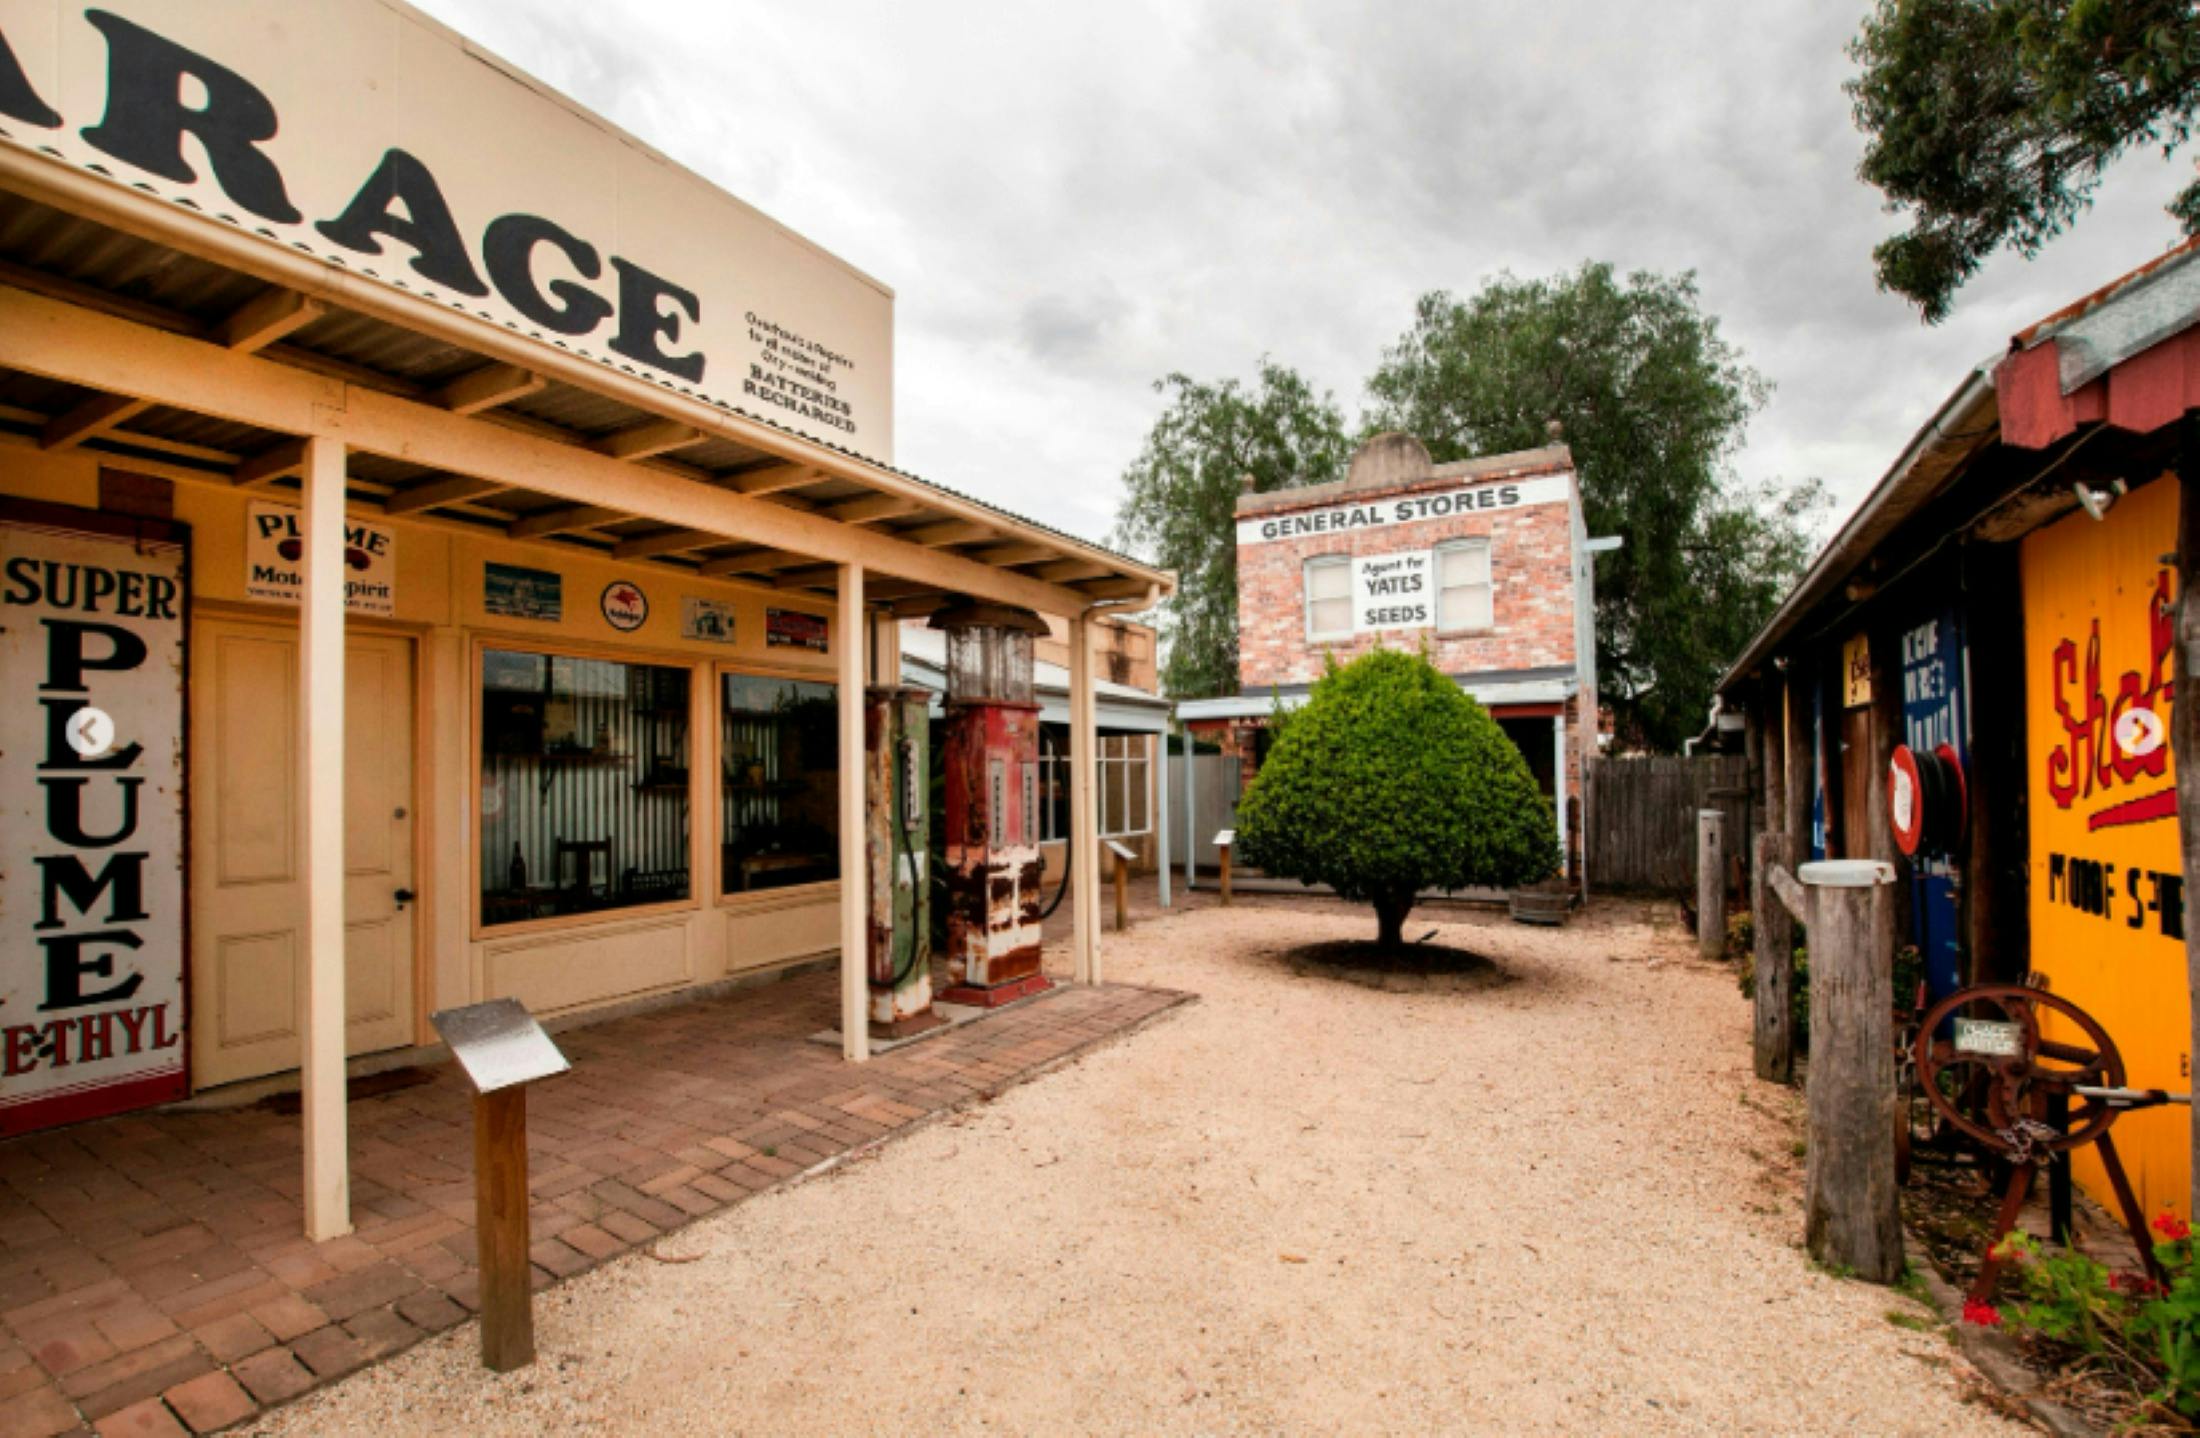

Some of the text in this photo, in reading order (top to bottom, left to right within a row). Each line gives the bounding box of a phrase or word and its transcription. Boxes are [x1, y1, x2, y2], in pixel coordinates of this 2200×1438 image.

[743, 378, 856, 434] RECHARGED
[750, 363, 851, 417] BATTERIES
[256, 513, 390, 557] PLME
[1261, 484, 1522, 540] GENERAL STORES
[4, 557, 177, 619] SUPER
[344, 580, 390, 599] pirit
[1365, 573, 1423, 597] YATES
[1365, 603, 1428, 625] SEEDS
[33, 617, 150, 1011] PLUME
[2, 1003, 178, 1076] ETHYL
